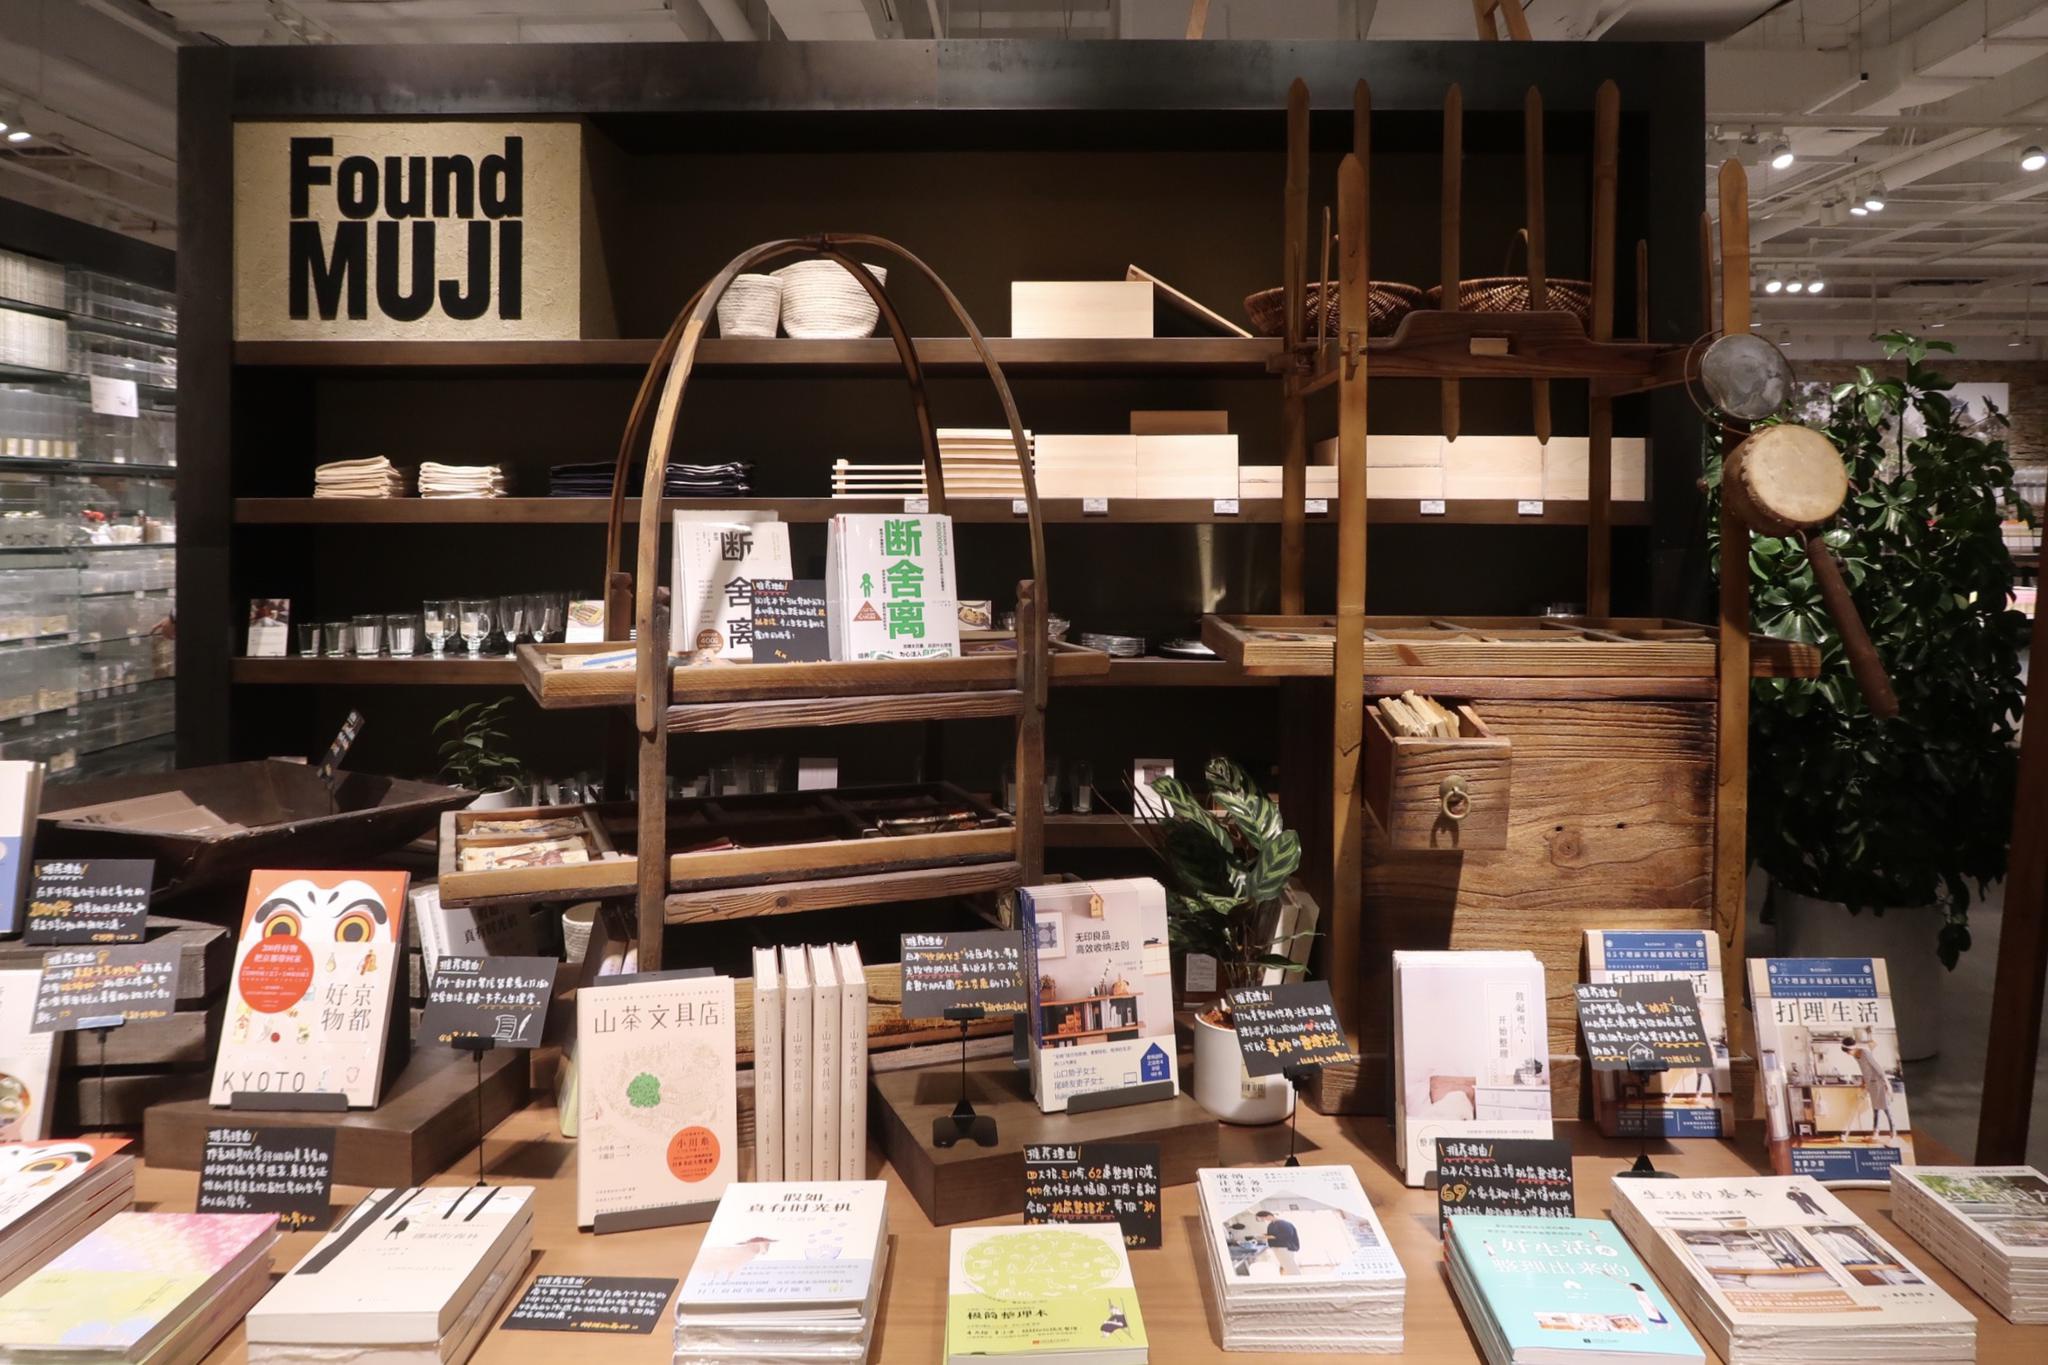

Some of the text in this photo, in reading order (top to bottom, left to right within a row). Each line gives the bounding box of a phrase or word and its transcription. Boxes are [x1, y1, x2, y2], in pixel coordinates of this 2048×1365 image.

[290, 136, 523, 219] Found
[289, 221, 523, 321] MUJI
[884, 519, 926, 640] 断舍离
[1075, 930, 1111, 943] 无印良品
[1076, 940, 1130, 954] 高效收纳法则
[349, 983, 375, 1032] 京都
[594, 1000, 719, 1034] 山茶文具店
[1776, 1001, 1879, 1023] 打理生活
[222, 1072, 306, 1092] KYOTO
[1027, 1146, 1077, 1160] 推荐理由
[1643, 1188, 1764, 1200] 生活的基本
[748, 1203, 851, 1213] 真有时光机
[1501, 1237, 1593, 1257] 好生活
